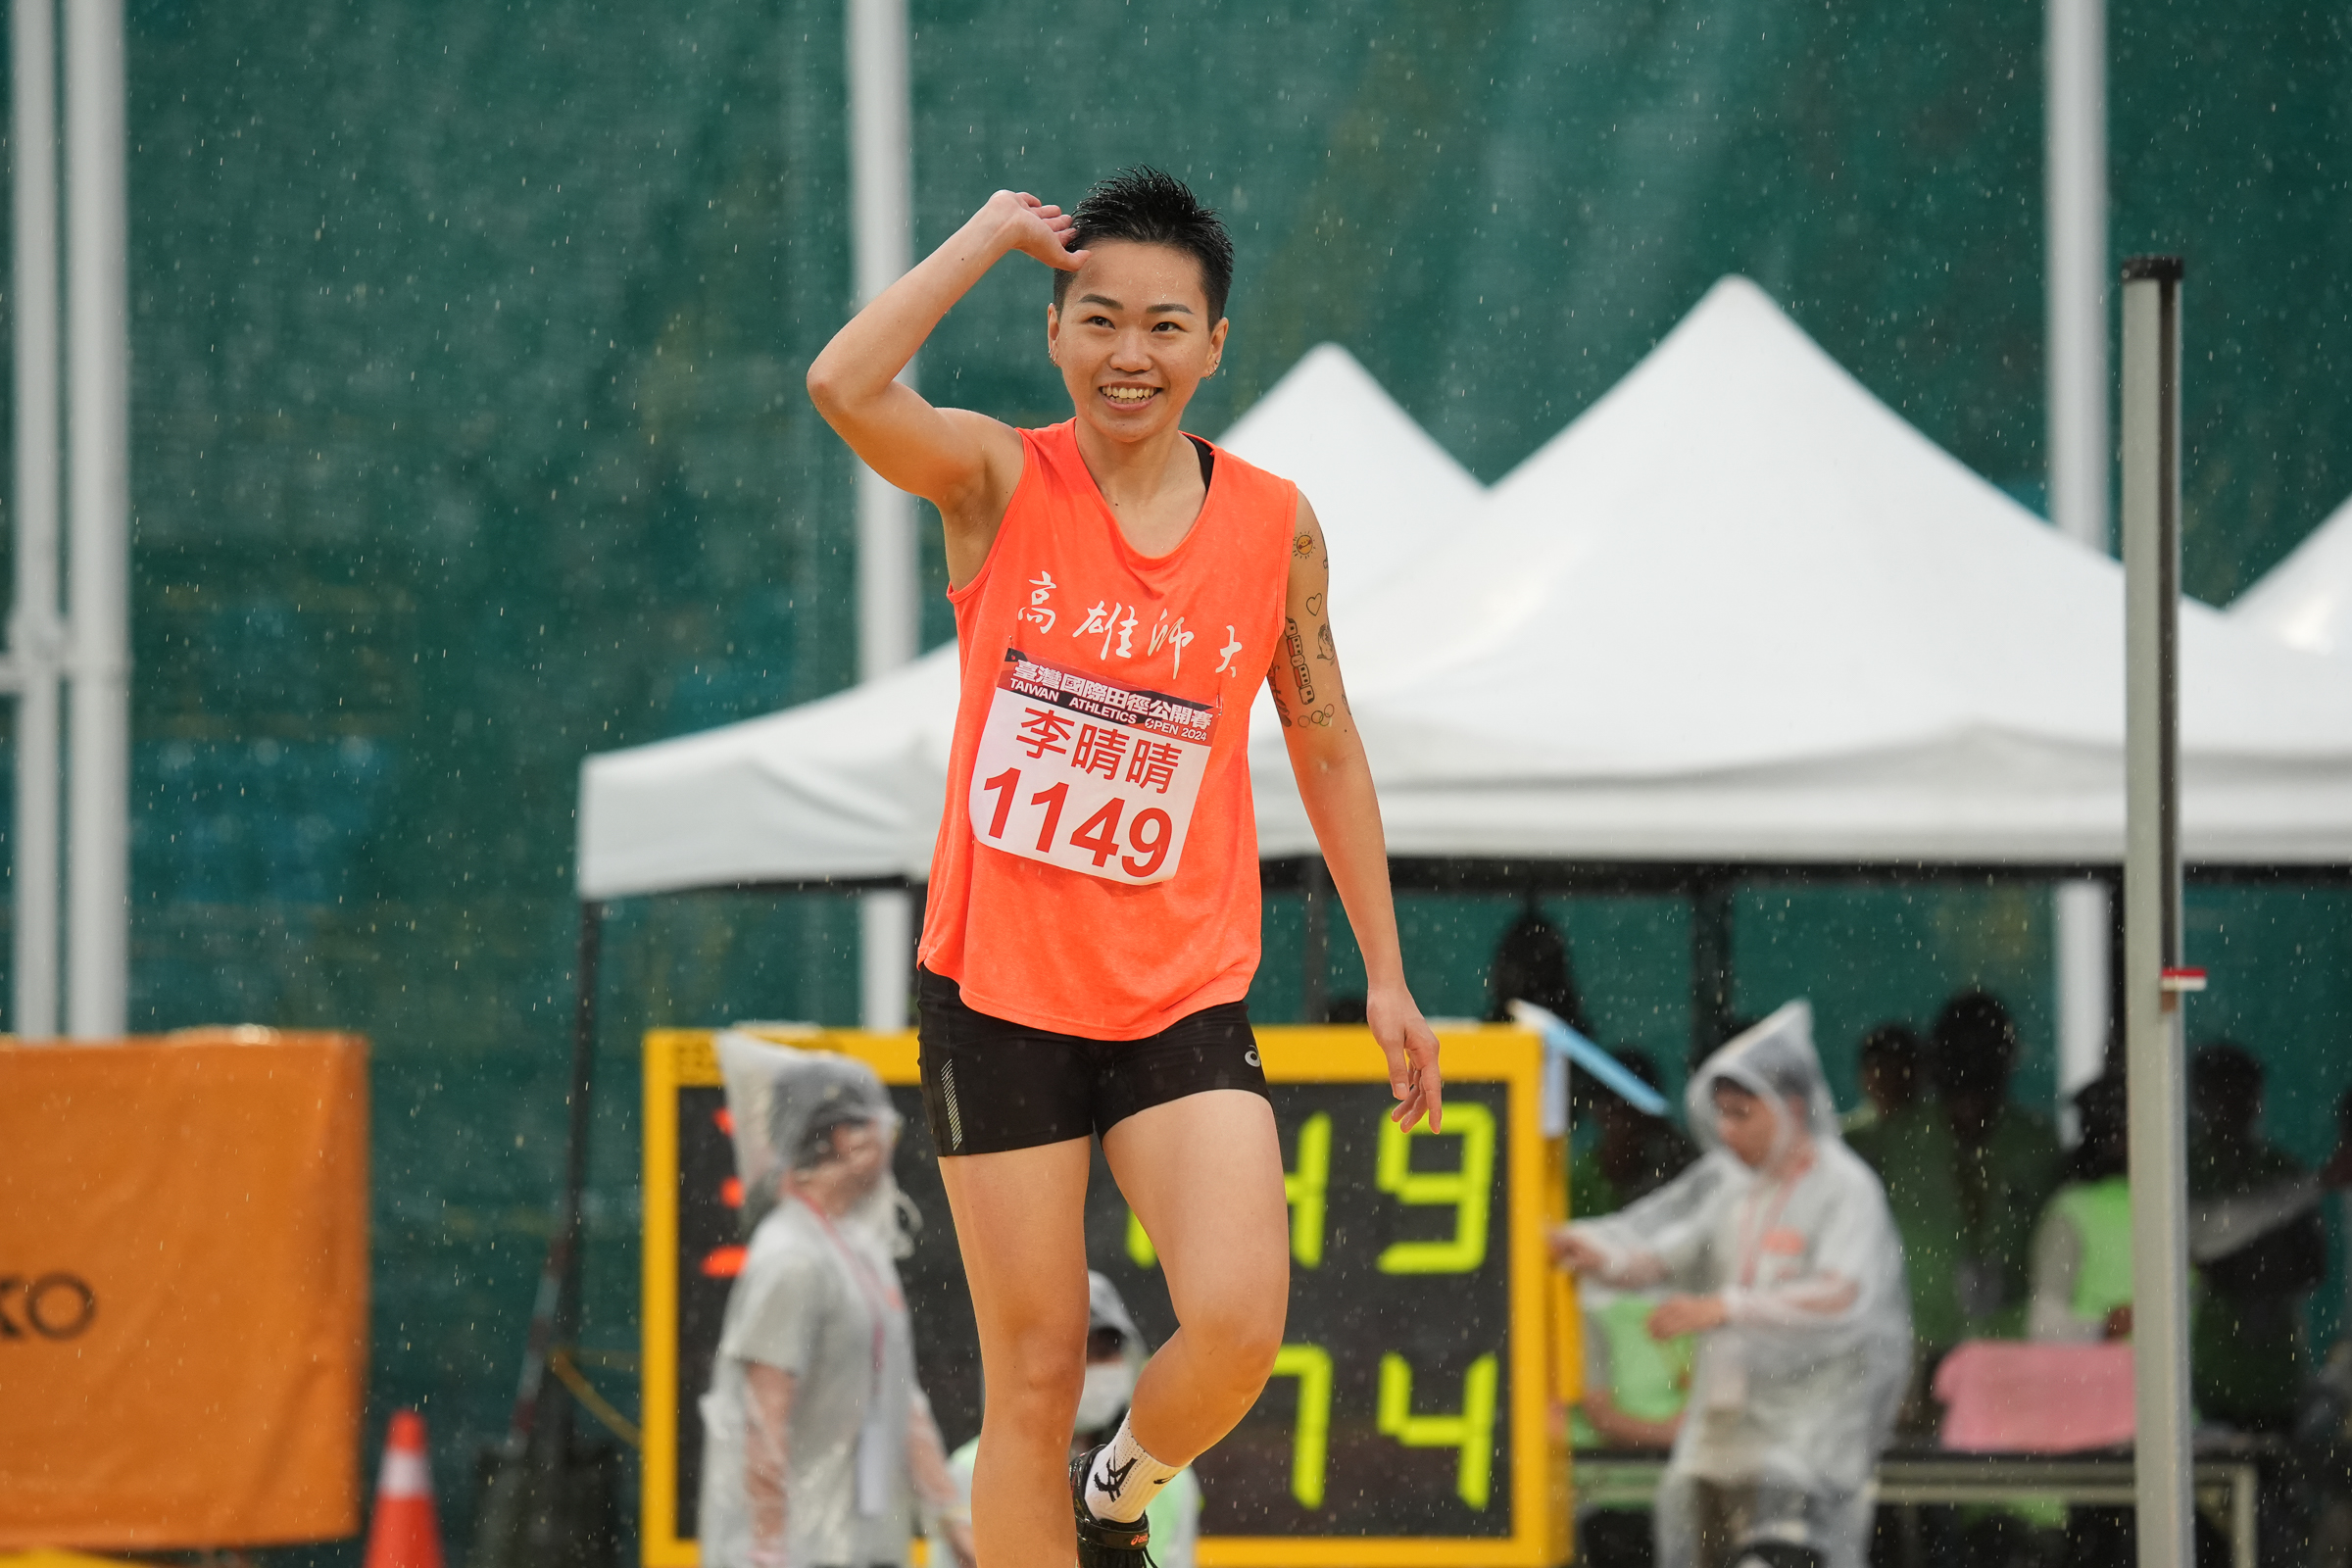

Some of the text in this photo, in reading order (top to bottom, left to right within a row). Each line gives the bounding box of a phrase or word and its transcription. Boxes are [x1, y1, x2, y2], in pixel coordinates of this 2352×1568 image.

[1009, 677, 1206, 742] TAIWAN ATHLETICS OPEN 2024
[1012, 659, 1214, 731] 臺灣國際田徑公開賽
[1015, 707, 1183, 794] 李晴晴
[983, 766, 1173, 878] 1149
